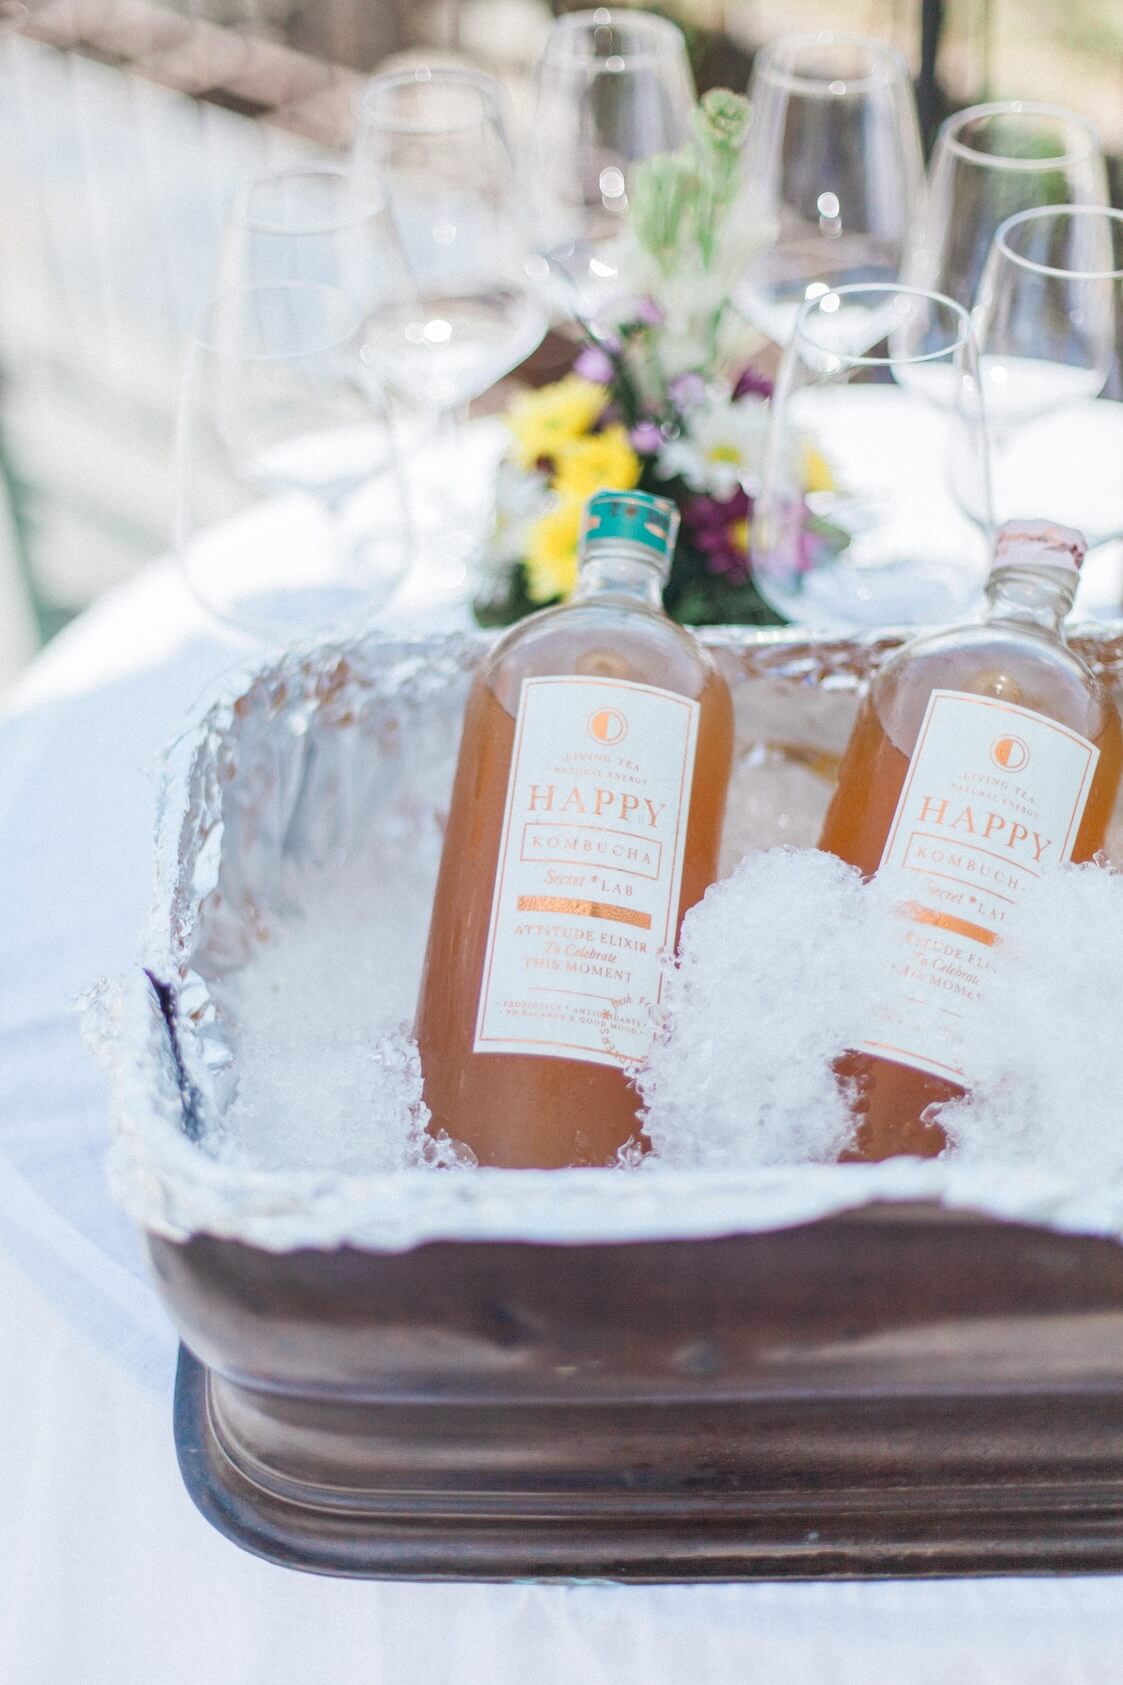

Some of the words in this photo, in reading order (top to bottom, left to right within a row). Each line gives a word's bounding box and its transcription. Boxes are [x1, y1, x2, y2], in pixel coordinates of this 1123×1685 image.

[564, 752, 612, 763] LIVING
[618, 756, 641, 773] TEA
[608, 771, 649, 785] ENERGY
[963, 772, 1009, 790] LIVING
[1014, 786, 1035, 804] TEA
[528, 784, 667, 828] HAPPY
[950, 782, 998, 801] NATURAL
[1002, 798, 1040, 819] ENERGY
[919, 796, 1052, 862] HAPPY
[532, 837, 652, 864] KOMBUCHA
[545, 869, 585, 888] Secret
[915, 846, 1026, 891] KOMBUCH
[514, 924, 595, 943] ATTITUDE
[600, 932, 649, 954] ELIXIR
[546, 941, 561, 954] To
[565, 942, 618, 964] Celebrate
[524, 957, 561, 971] THIS
[566, 962, 634, 983] MOMENT
